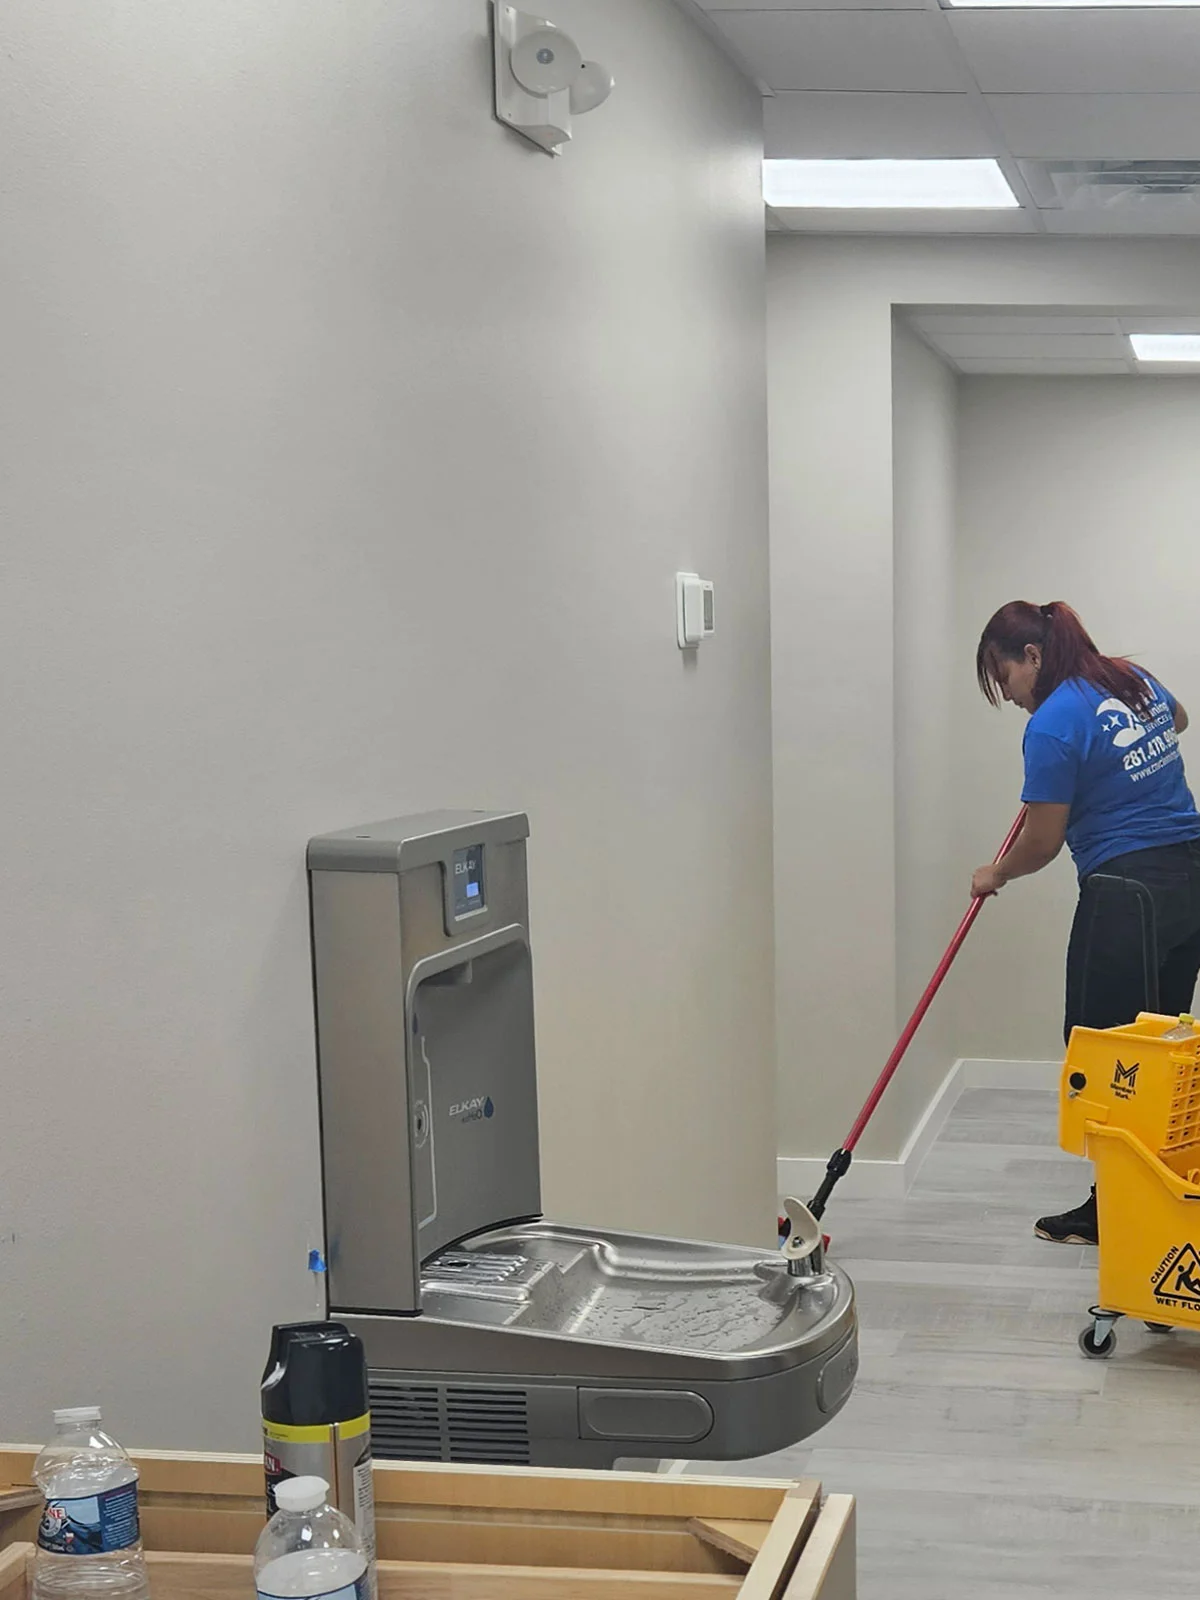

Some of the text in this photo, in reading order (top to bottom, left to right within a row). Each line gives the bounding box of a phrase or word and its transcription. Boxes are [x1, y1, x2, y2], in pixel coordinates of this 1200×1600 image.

[455, 860, 477, 875] ELKAY
[448, 1096, 485, 1116] ELKAY
[1150, 1245, 1179, 1284] CAUTION
[1156, 1297, 1178, 1307] WET
